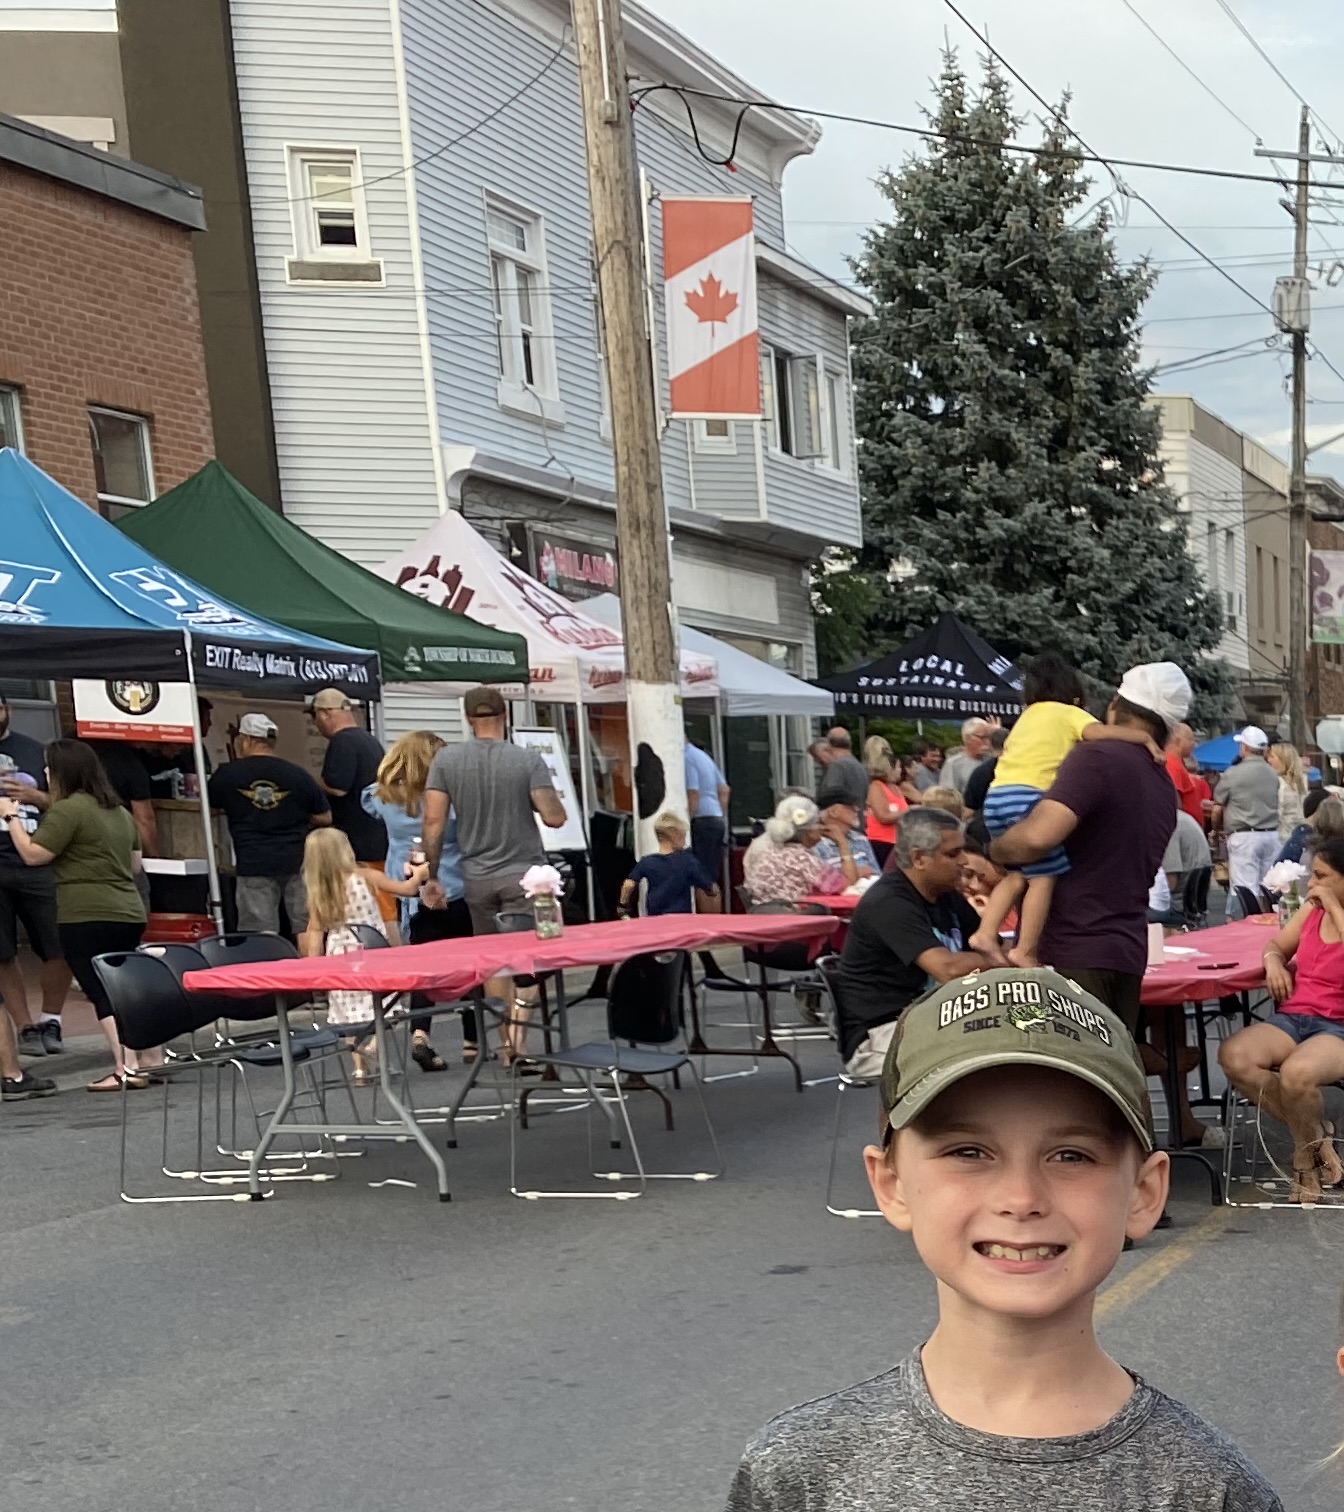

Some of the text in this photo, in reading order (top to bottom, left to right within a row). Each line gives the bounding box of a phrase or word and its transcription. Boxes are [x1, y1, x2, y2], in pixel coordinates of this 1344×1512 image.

[205, 644, 231, 668] EXIT
[232, 649, 264, 678] Realty
[265, 653, 296, 678] Matrix
[898, 654, 965, 677] LOCAL
[857, 675, 996, 693] SUSTAINABLE
[864, 693, 899, 707] FIRST
[903, 696, 955, 710] ORGANIC
[939, 982, 1112, 1047] BASS PRO SHOPS
[963, 1017, 1002, 1034] SINCE
